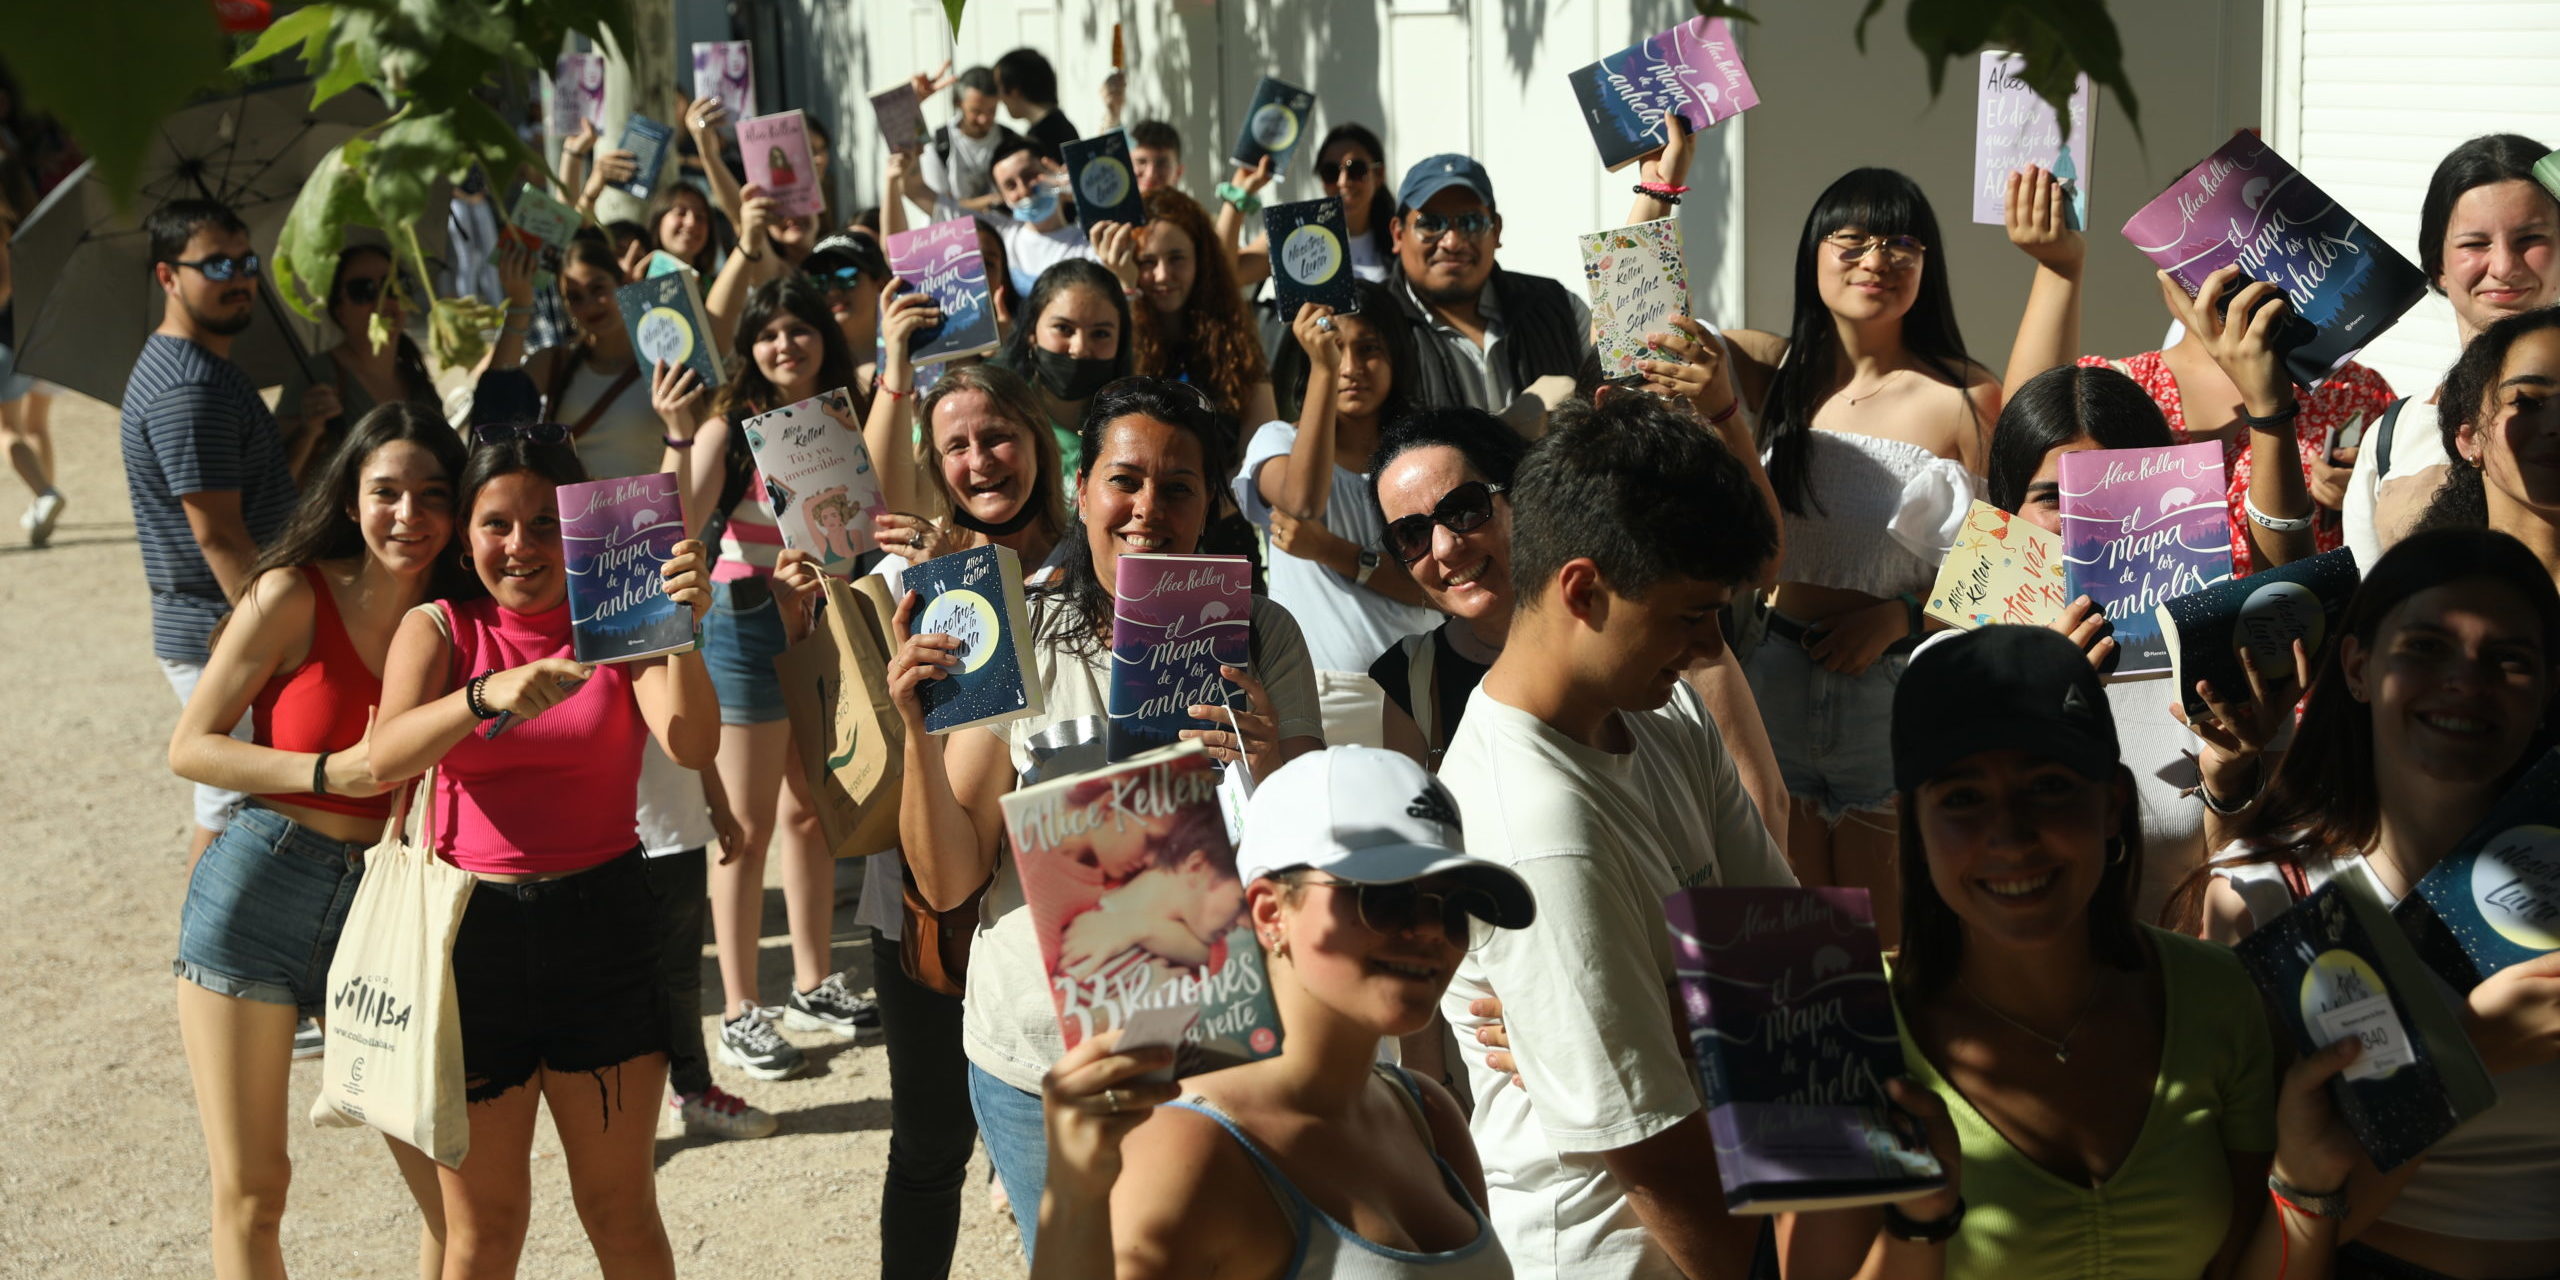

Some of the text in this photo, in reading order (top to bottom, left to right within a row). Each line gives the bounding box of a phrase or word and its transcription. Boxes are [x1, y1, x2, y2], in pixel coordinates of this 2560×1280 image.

[1702, 41, 1725, 66] Alice
[1987, 63, 2026, 94] Alice
[1608, 74, 1665, 137] anhelos
[1986, 98, 2008, 129] El
[1985, 134, 2013, 154] que
[2043, 123, 2060, 147] de
[2178, 156, 2240, 223] Alice Kellen
[911, 234, 929, 254] Alice
[1287, 233, 1326, 263] Nosotros
[2228, 217, 2246, 248] El
[2286, 237, 2307, 258] los
[1300, 253, 1328, 280] Luna
[1615, 264, 1645, 286] Kellen
[1618, 255, 1638, 271] Alice
[2289, 231, 2360, 314] nhelos
[940, 289, 978, 316] helos
[1615, 275, 1660, 313] Las alas
[1636, 298, 1647, 313] de
[1624, 301, 1666, 335] Sophie
[781, 424, 802, 442] Alice
[794, 424, 826, 447] Kellen
[784, 455, 847, 483] invencibles
[787, 451, 804, 466] Tú
[2096, 451, 2188, 491] Alice Kellen
[589, 480, 650, 515] Alice Kellen
[2120, 506, 2142, 534] El
[605, 525, 621, 549] El
[606, 564, 648, 590] de los
[961, 562, 990, 586] Kellen
[964, 554, 984, 572] Alice
[2119, 553, 2178, 584] de los
[1155, 566, 1226, 598] Alice Kellen
[1967, 554, 1993, 606] Kellen
[2104, 563, 2210, 622] anhelos
[1948, 578, 1968, 615] Alice
[1165, 614, 1185, 640] El
[1157, 661, 1208, 686] de los
[1137, 672, 1230, 721] anhelos
[1016, 802, 1103, 853] Alice
[1109, 763, 1216, 833] Kellen
[2484, 877, 2559, 922] Luna
[1055, 972, 1122, 1043] 33
[1206, 997, 1258, 1041] verte
